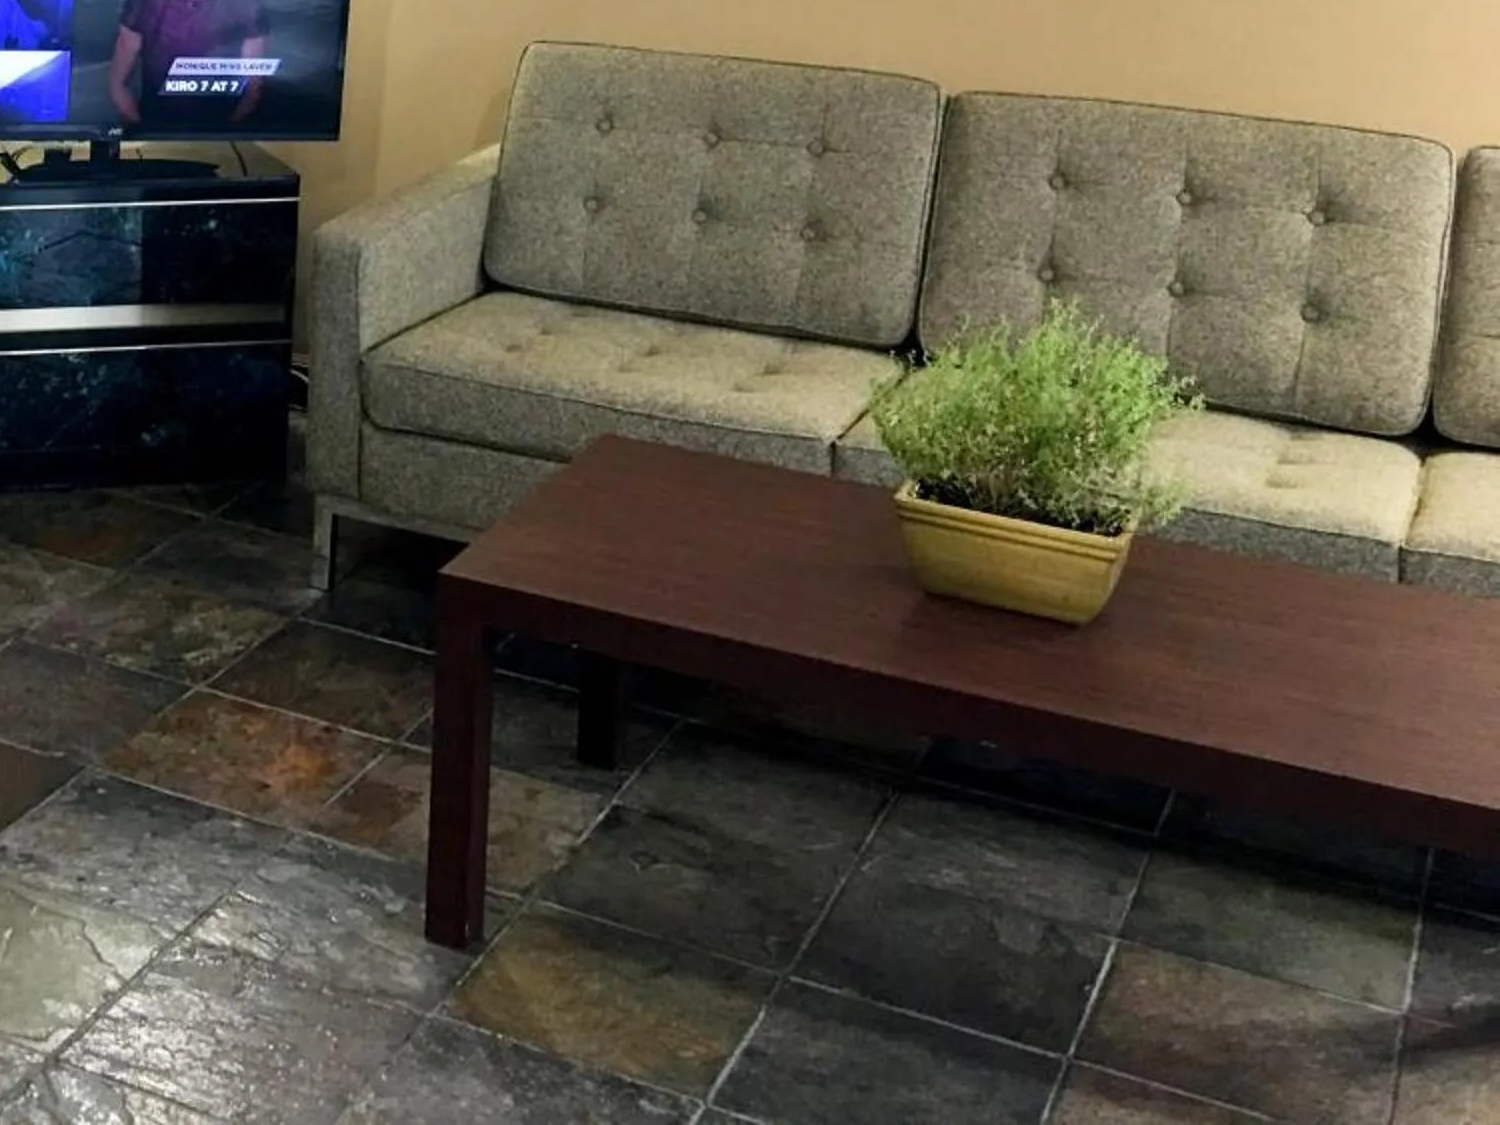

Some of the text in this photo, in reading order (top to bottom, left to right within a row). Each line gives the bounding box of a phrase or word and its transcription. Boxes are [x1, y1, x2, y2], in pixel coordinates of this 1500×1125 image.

[165, 80, 239, 91] KIRO 7 AT 7
